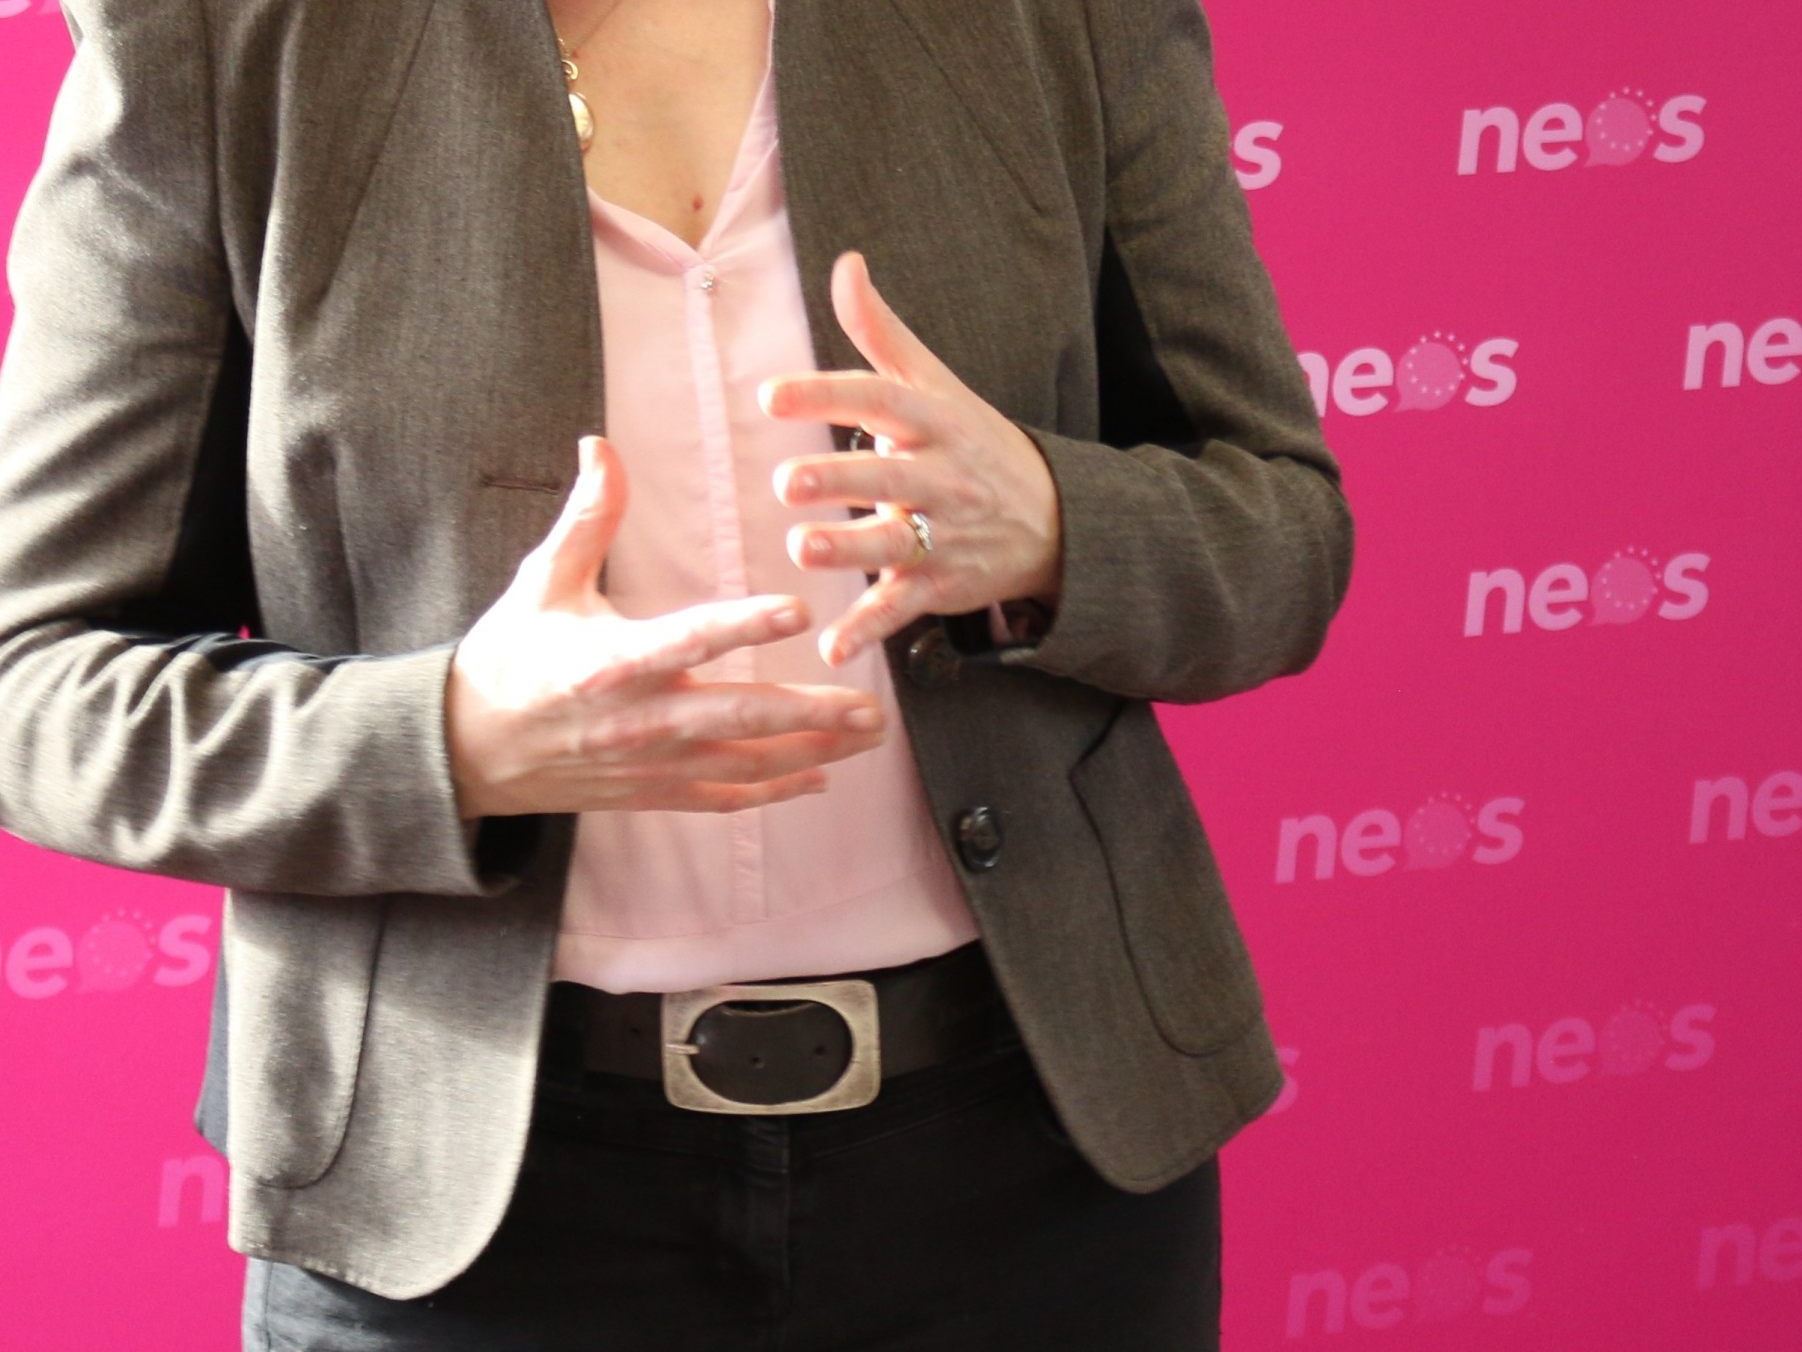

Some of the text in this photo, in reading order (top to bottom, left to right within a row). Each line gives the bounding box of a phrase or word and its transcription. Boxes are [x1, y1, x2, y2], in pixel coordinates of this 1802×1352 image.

[1457, 94, 1705, 174] neos
[1464, 552, 1709, 636] neos
[1275, 797, 1523, 883] neos
[5, 910, 212, 1000] eos
[1472, 1003, 1715, 1091] neos
[1284, 1248, 1531, 1339] neos
